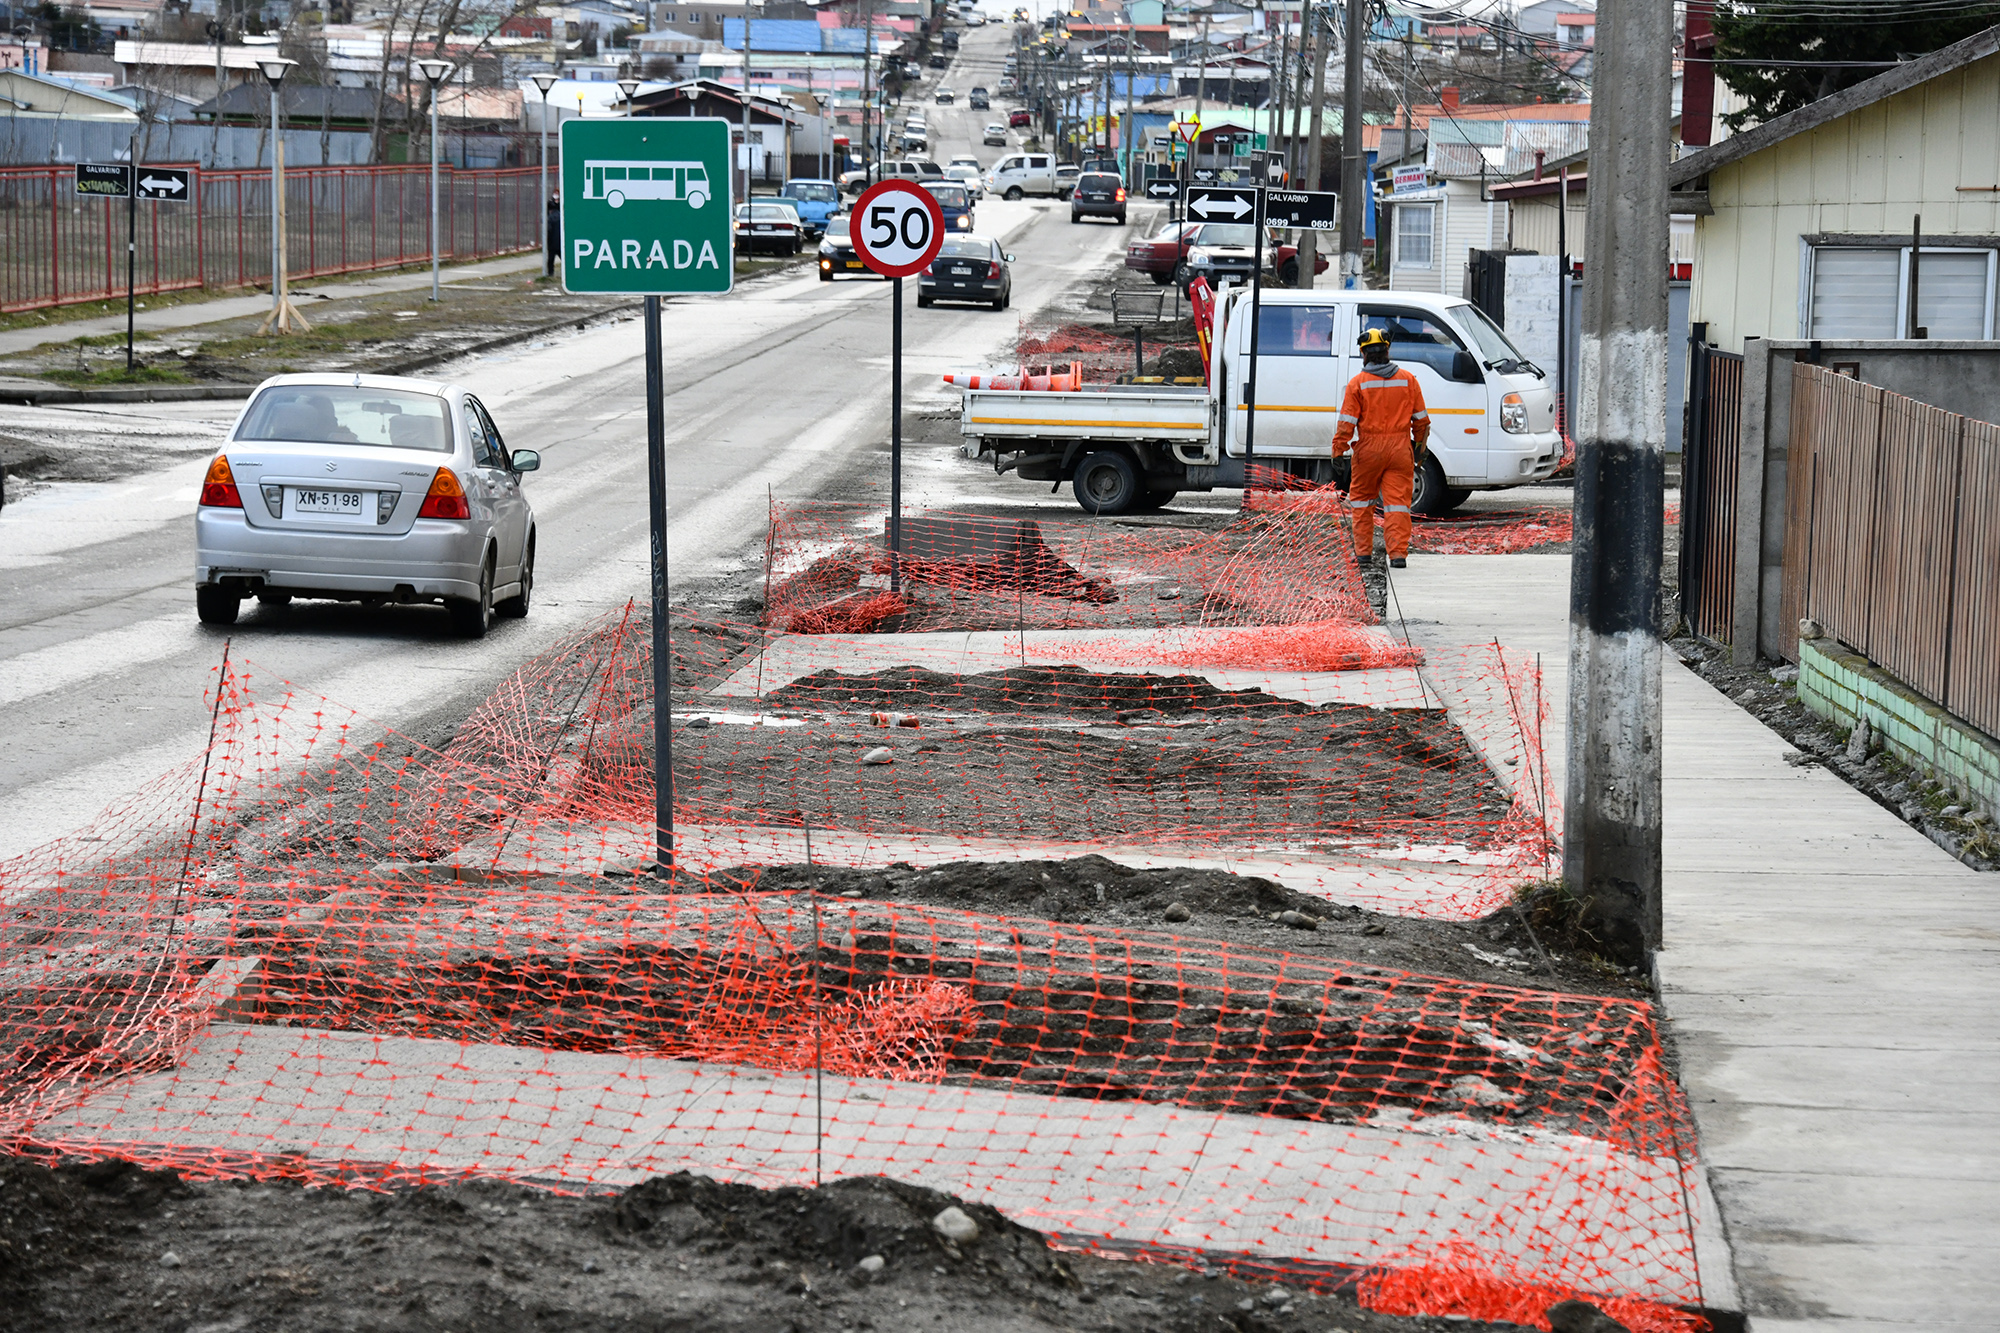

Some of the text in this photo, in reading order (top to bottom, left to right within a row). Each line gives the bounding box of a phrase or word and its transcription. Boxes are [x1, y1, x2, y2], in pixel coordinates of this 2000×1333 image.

[86, 166, 120, 174] GALVARINO
[1395, 173, 1424, 184] GERMANY
[1268, 193, 1309, 203] GALVARINO
[870, 206, 929, 250] 50
[1266, 217, 1333, 228] 0699 0601
[574, 239, 719, 269] PARADA
